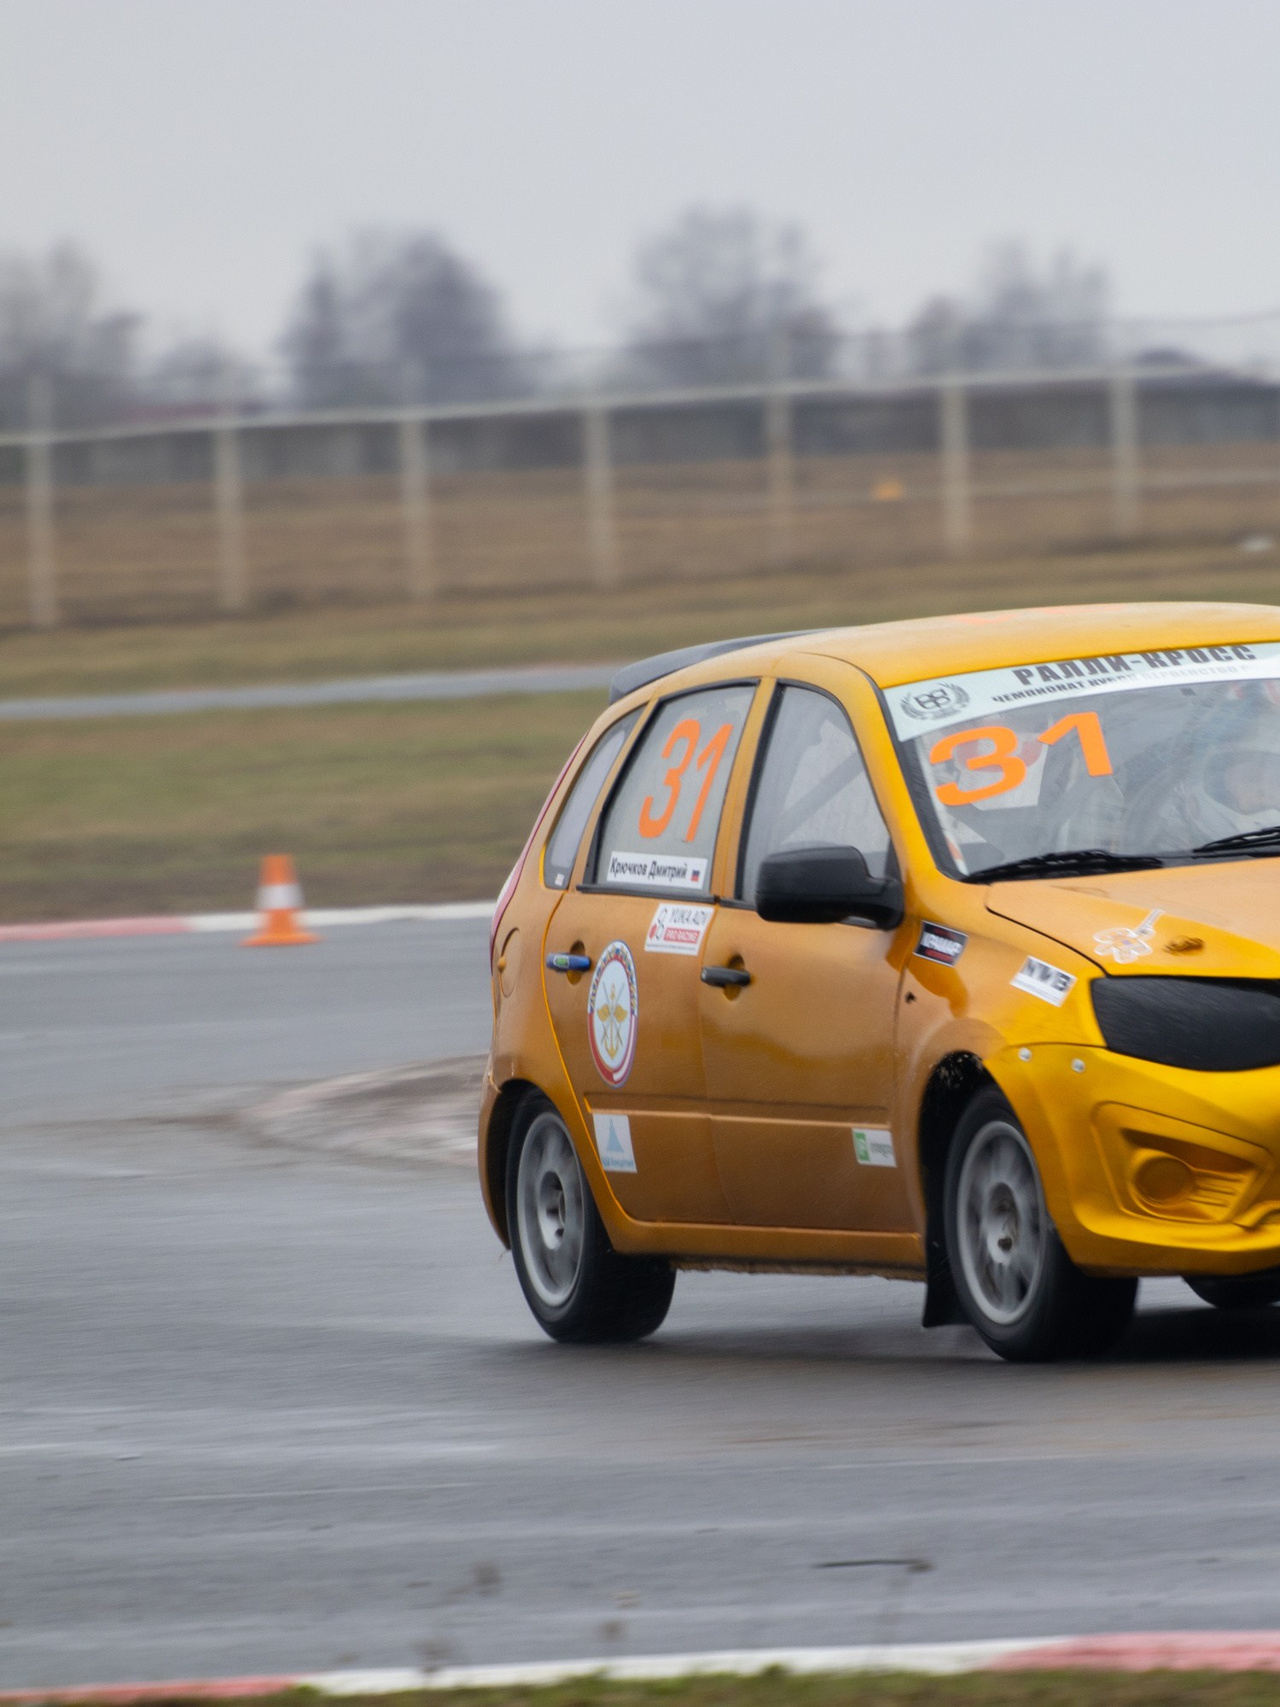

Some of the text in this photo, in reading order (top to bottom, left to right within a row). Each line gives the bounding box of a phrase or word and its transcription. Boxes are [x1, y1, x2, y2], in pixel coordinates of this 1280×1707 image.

[1012, 645, 1256, 686] РАЛЛИ-КРОСС
[638, 718, 734, 843] 31
[929, 711, 1113, 806] 31
[610, 857, 687, 881] Крючков Дмитрий
